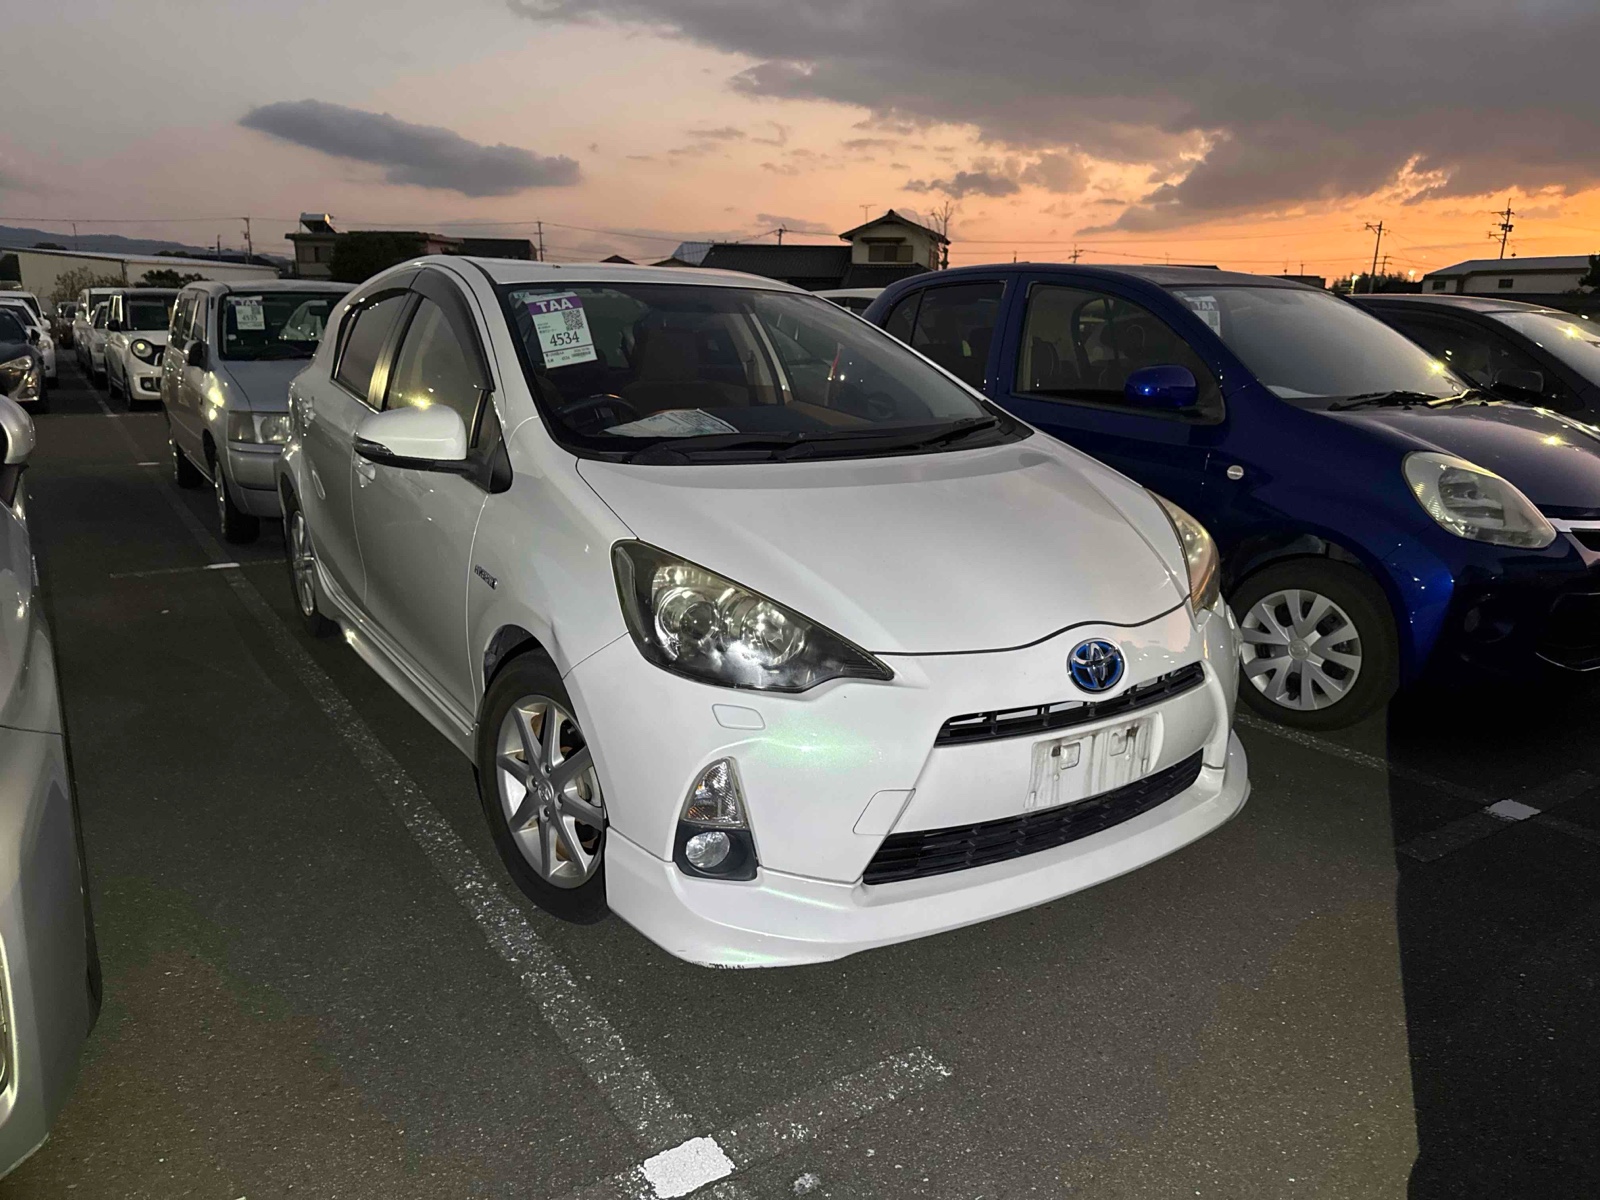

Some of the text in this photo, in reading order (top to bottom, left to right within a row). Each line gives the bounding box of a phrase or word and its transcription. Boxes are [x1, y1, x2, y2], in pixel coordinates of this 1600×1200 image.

[536, 298, 574, 313] TAA
[1194, 301, 1215, 310] TAA
[549, 331, 580, 347] 4534
